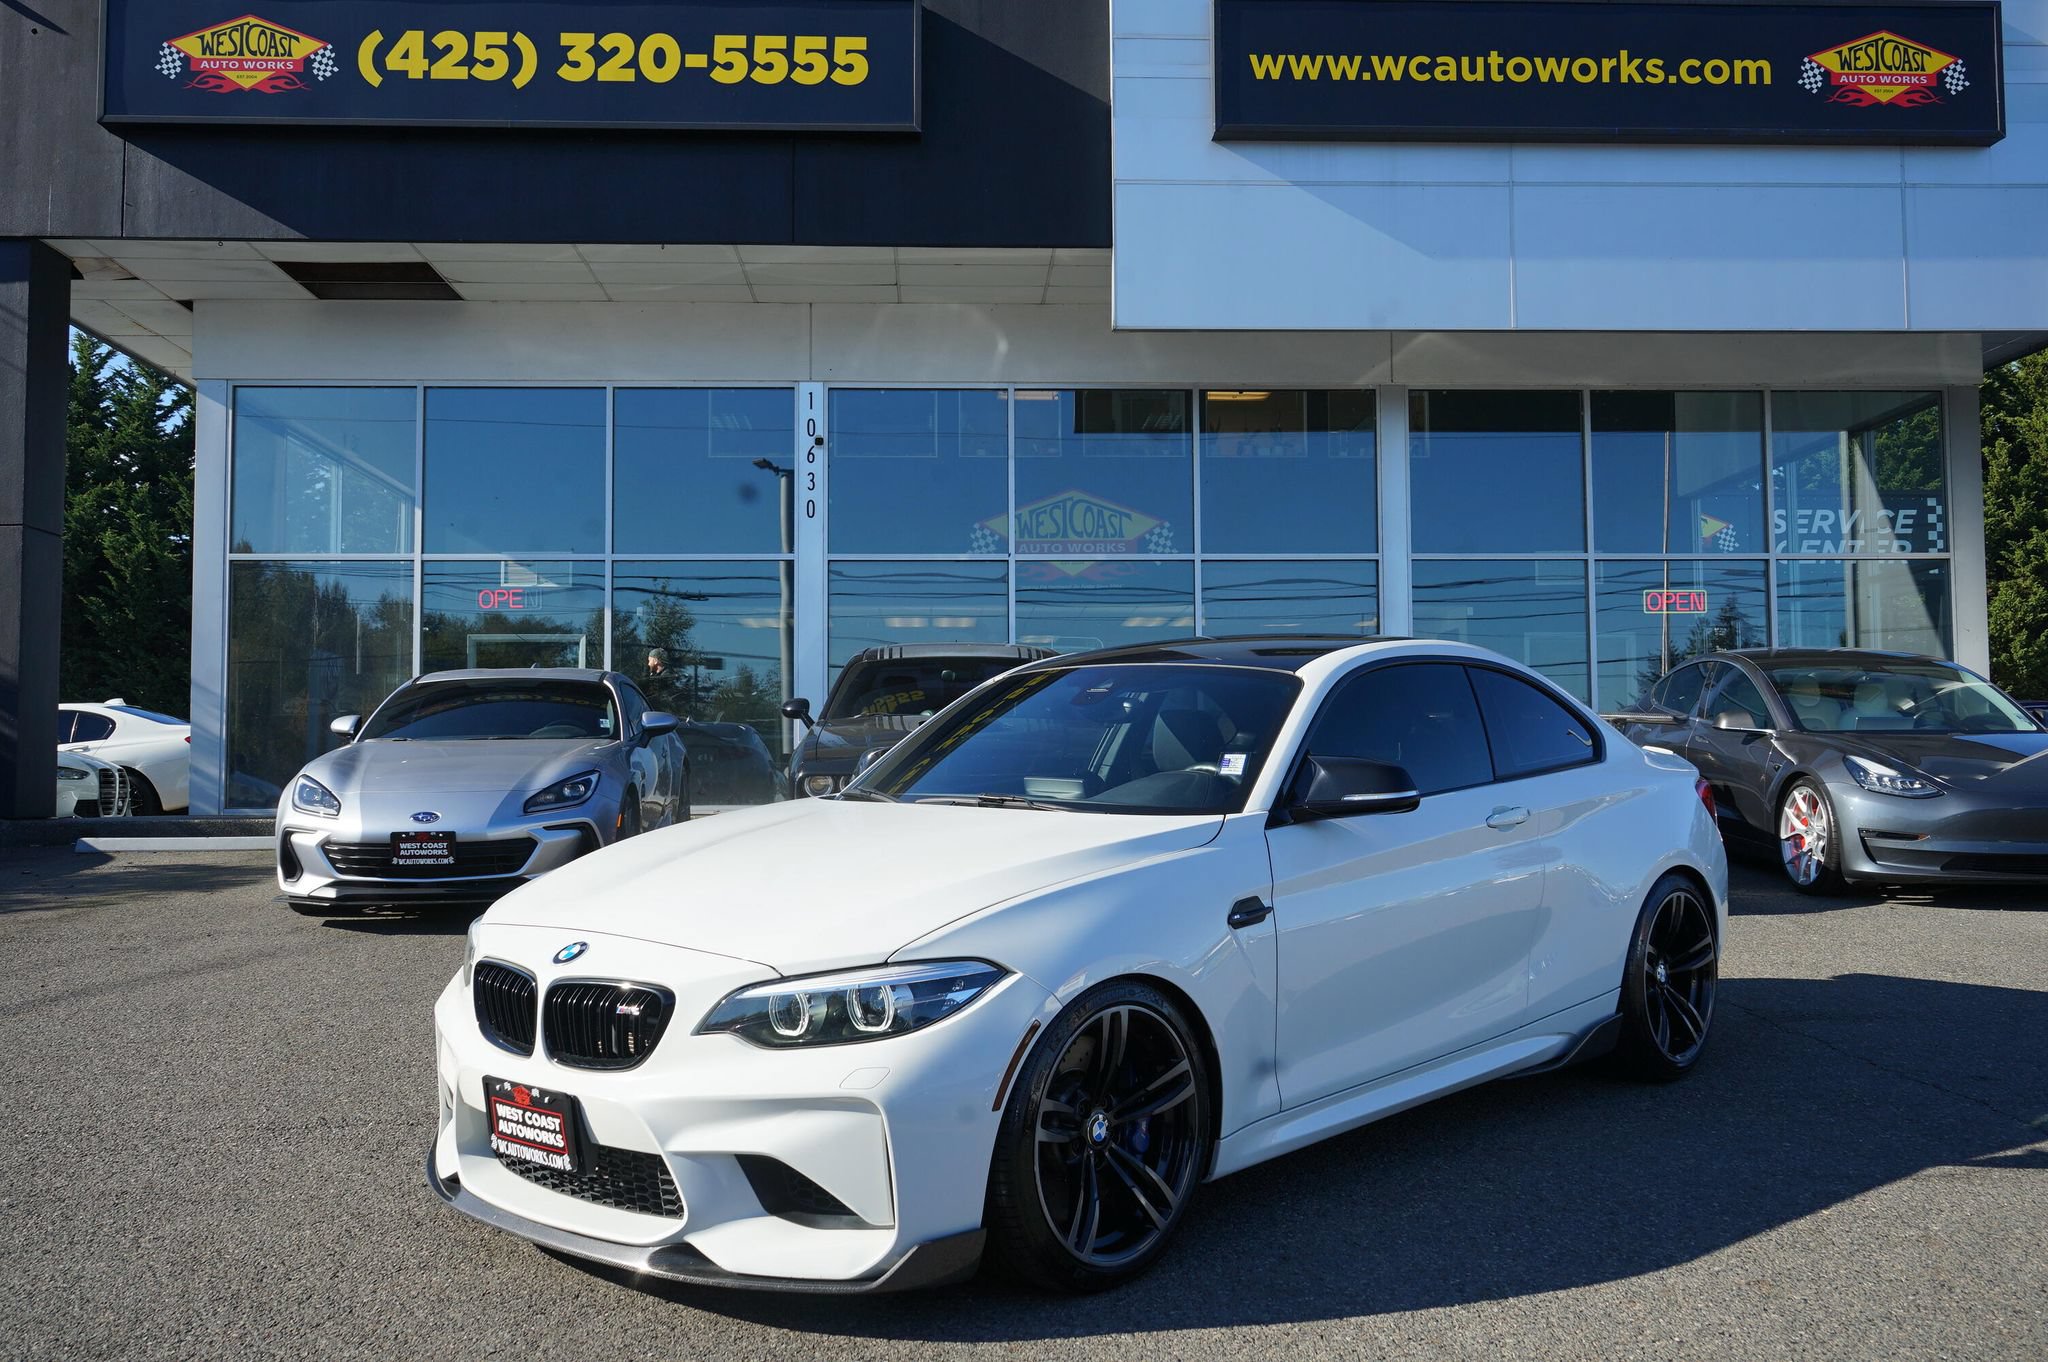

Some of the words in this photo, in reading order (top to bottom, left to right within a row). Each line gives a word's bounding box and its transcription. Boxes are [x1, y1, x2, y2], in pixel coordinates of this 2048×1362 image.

[200, 60, 239, 70] AUTO
[243, 60, 294, 70] WORKS
[358, 29, 538, 90] (425)
[556, 31, 869, 86] 320-5555
[1249, 49, 1772, 86] www.wcautoworks.com
[1839, 75, 1876, 84] AUTO
[1879, 75, 1927, 84] WORKS
[806, 391, 816, 519] 10630
[1018, 543, 1063, 553] AUTO
[1067, 542, 1126, 553] WORKS
[1646, 591, 1705, 612] OPEN
[495, 1103, 524, 1123] WEST
[524, 1111, 561, 1132] COAST
[498, 1119, 565, 1148] AUTOWORKS
[497, 1139, 565, 1170] WCAUTOWORKS.COM
